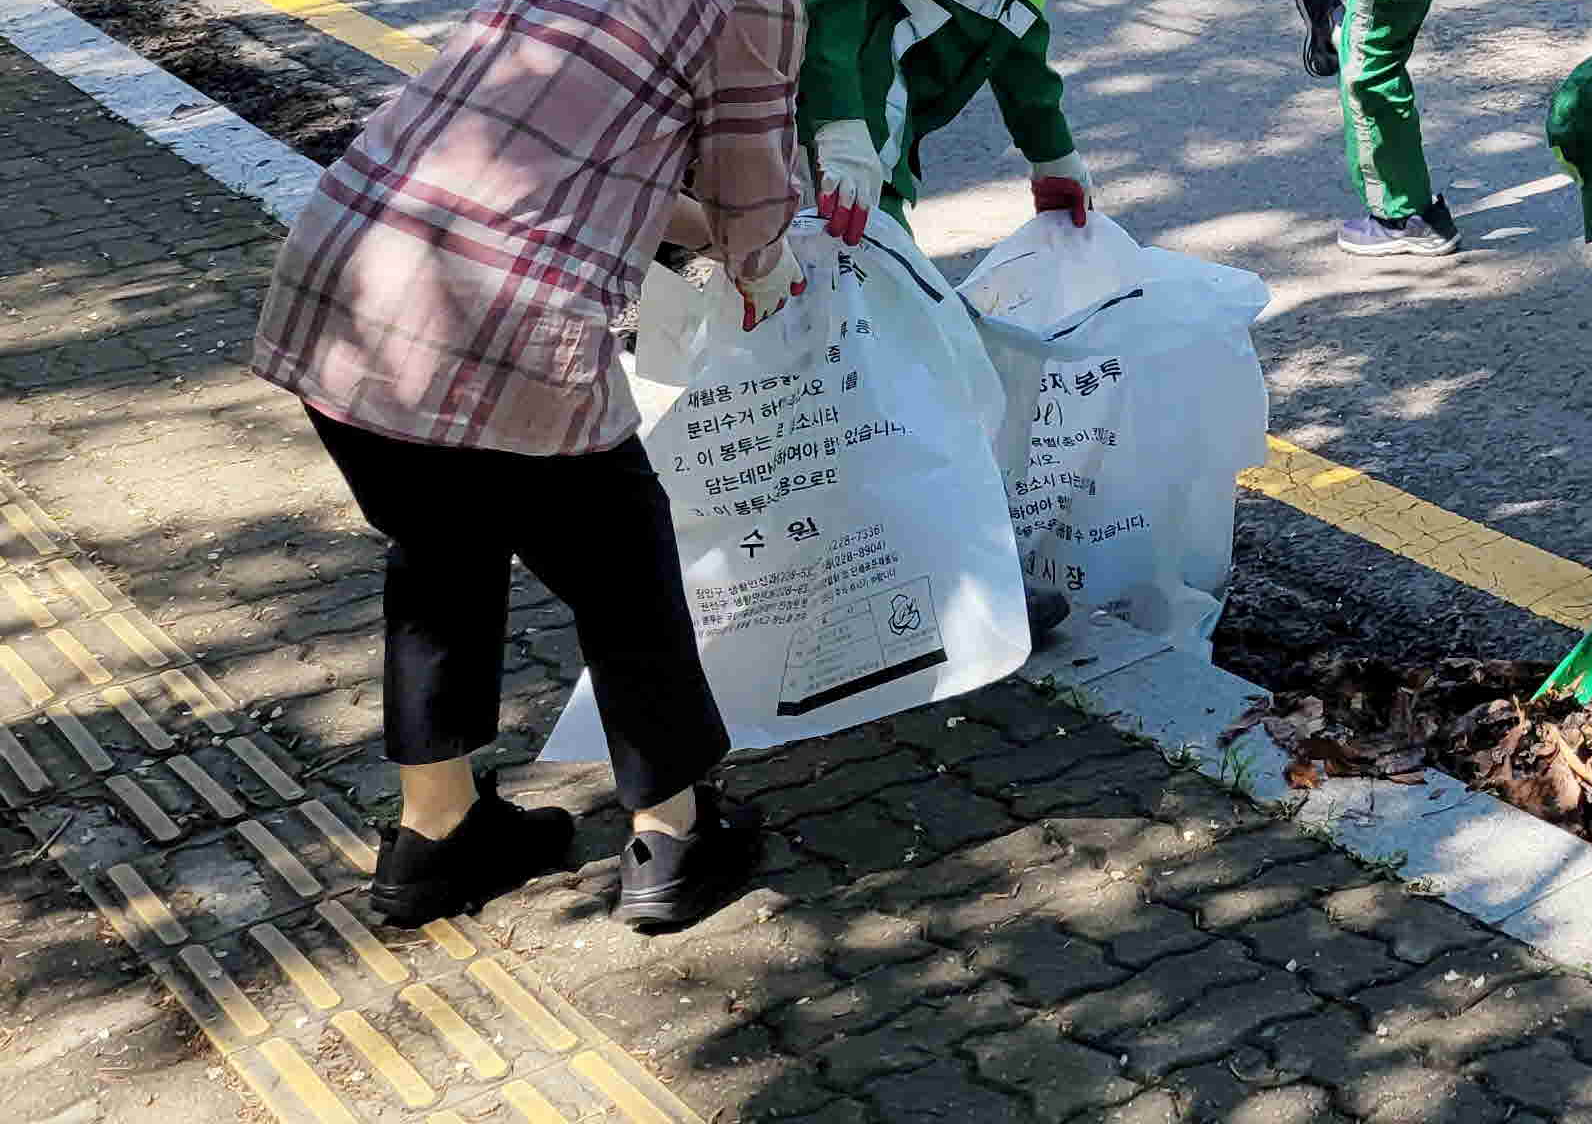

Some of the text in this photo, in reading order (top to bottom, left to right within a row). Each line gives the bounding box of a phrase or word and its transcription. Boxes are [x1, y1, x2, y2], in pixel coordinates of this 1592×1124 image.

[1074, 358, 1122, 397] 봉투
[687, 385, 733, 408] 재활용
[687, 408, 755, 440] 분리수거
[674, 456, 690, 472] 2.
[697, 448, 714, 466] 이
[720, 435, 773, 462] 봉투는
[704, 462, 775, 495] 담는데만
[739, 516, 820, 558] 수 원
[1088, 514, 1150, 544] 있습니다.
[1065, 564, 1086, 590] 장
